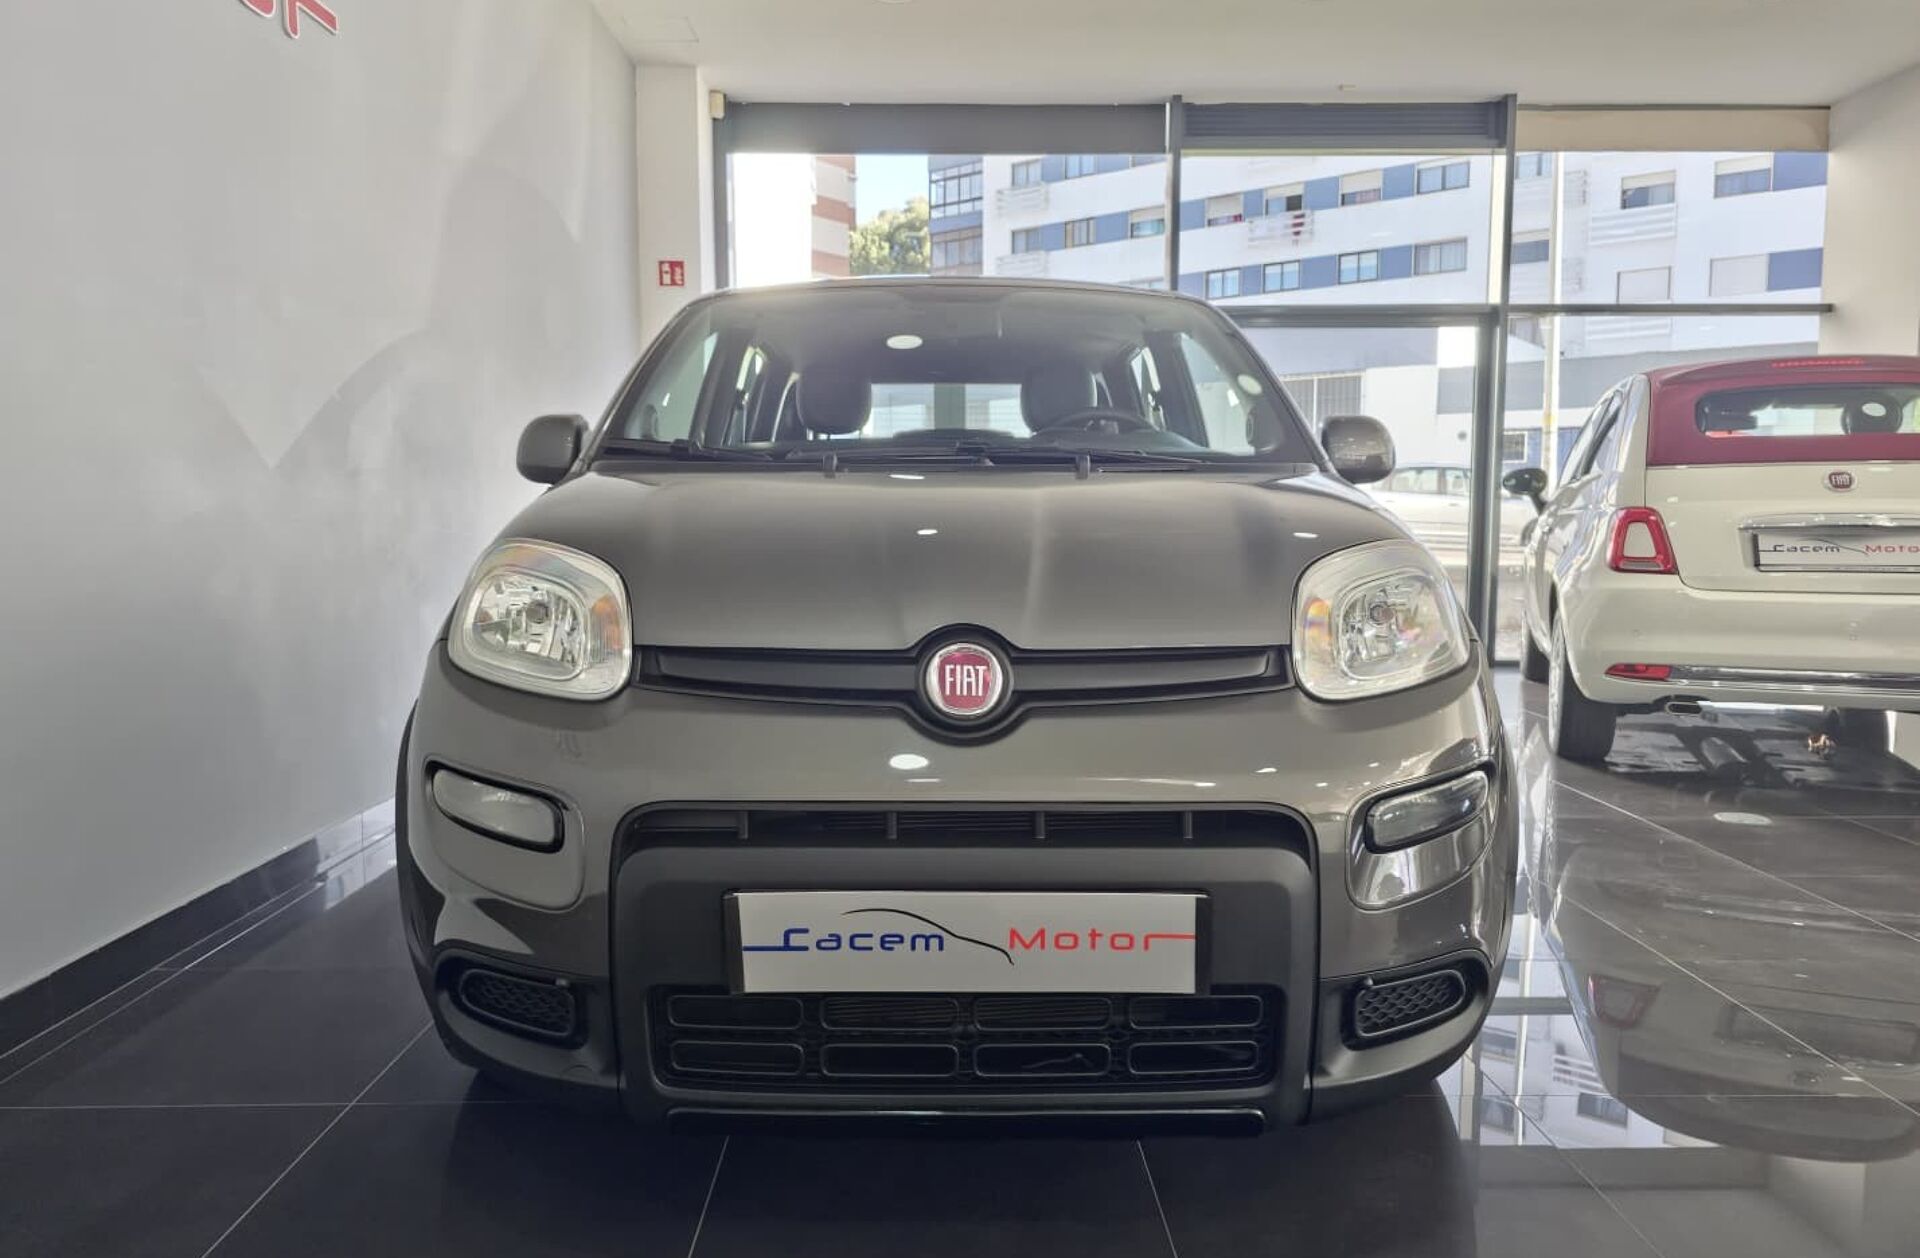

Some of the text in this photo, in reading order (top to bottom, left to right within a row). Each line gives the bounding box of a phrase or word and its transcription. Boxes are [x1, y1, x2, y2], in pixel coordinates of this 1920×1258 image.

[1831, 474, 1851, 486] FIAT
[944, 664, 988, 696] FIAT
[743, 928, 1197, 952] Cacem Motor
